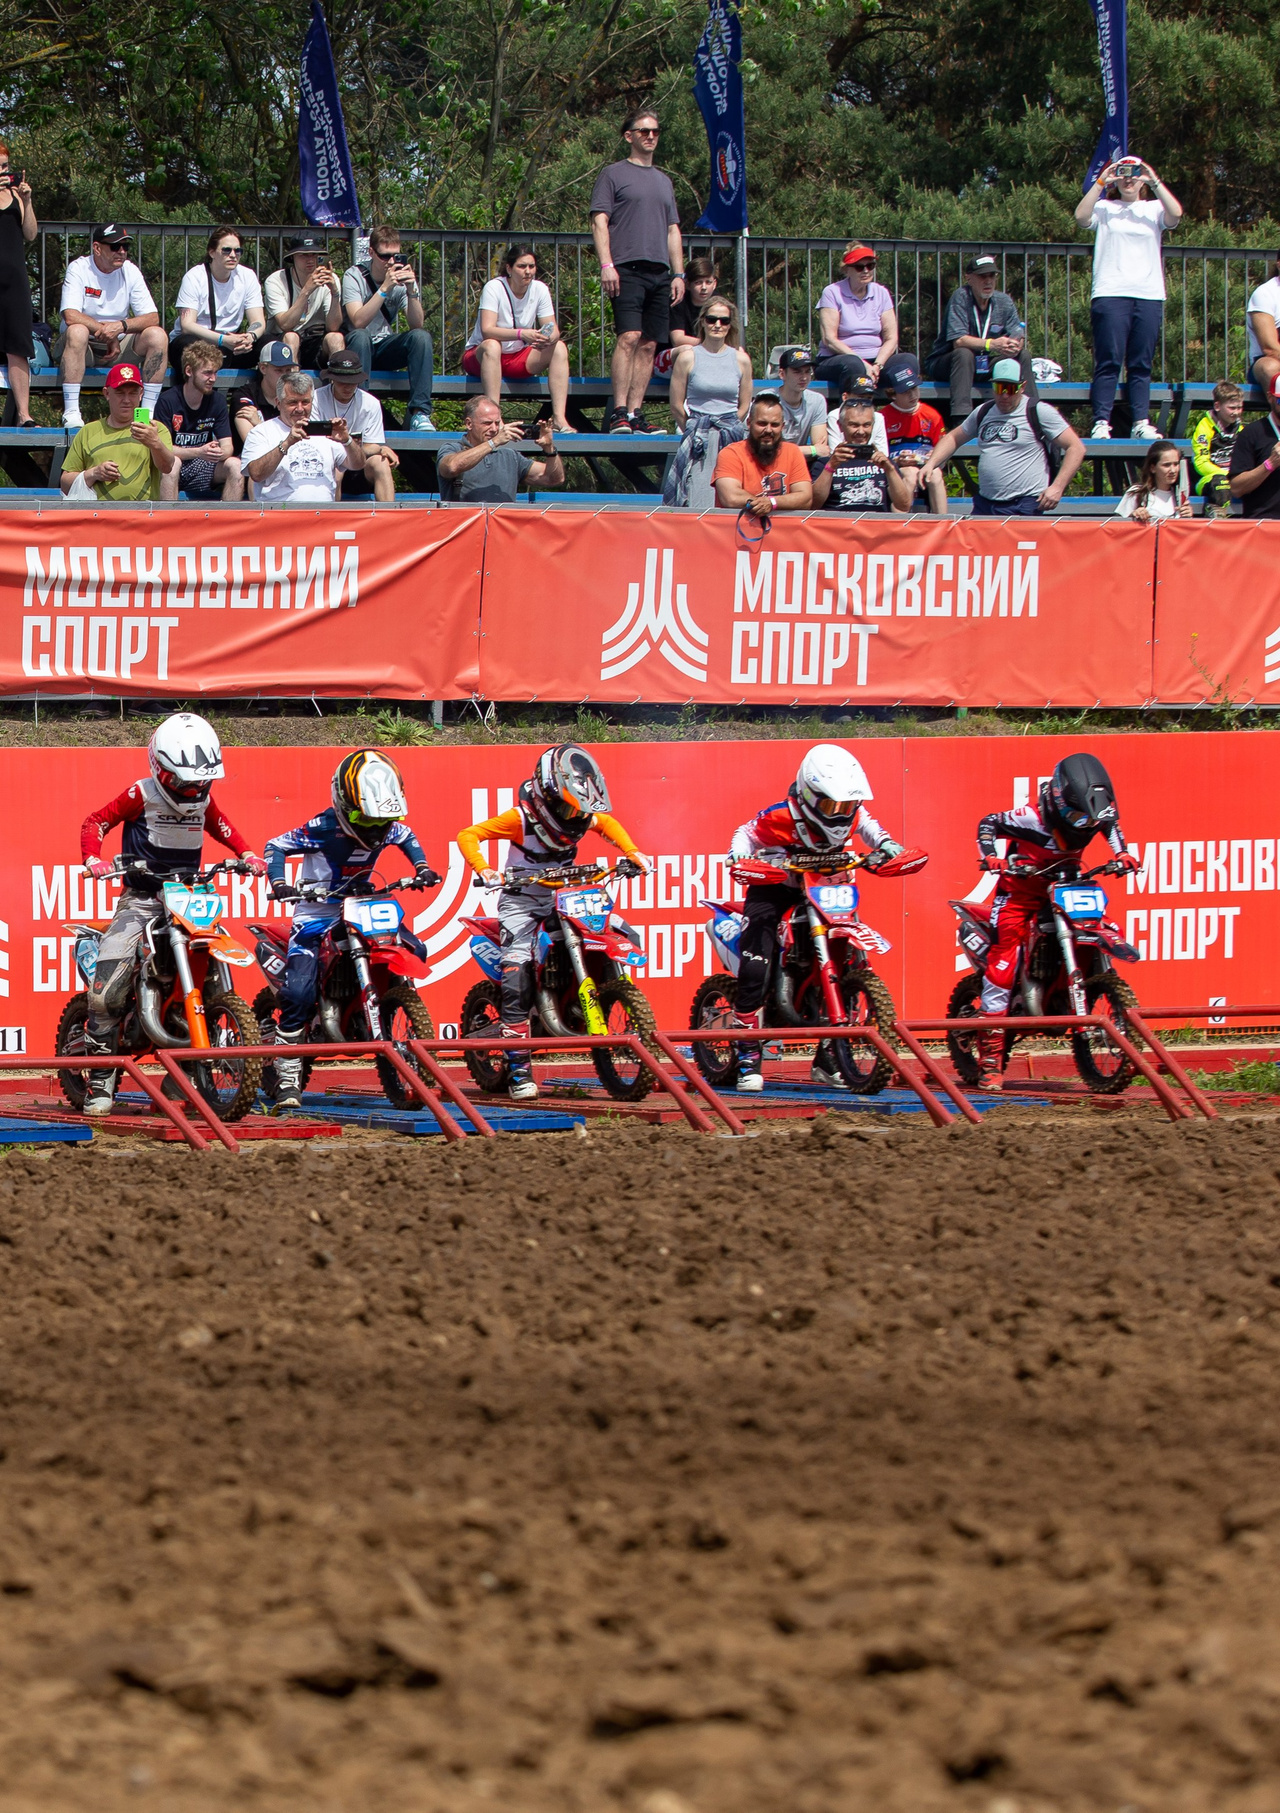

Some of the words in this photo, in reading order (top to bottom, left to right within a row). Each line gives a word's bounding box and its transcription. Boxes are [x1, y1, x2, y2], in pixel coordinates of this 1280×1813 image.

[23, 531, 360, 609] МОСКОВСКИЙ
[733, 540, 1040, 618] МОСКОВСКИЙ
[22, 616, 180, 681] СПОРТ
[730, 621, 879, 686] СПОРТ
[1126, 838, 1280, 896] МОСКОВ
[173, 894, 220, 918] 737
[819, 886, 854, 909] 98
[1061, 889, 1105, 913] 151
[358, 903, 399, 933] 19
[962, 931, 988, 956] 151
[1125, 906, 1243, 962] СПОРТ
[262, 954, 287, 976] 19
[472, 941, 501, 966] 612
[0, 1028, 23, 1052] 11
